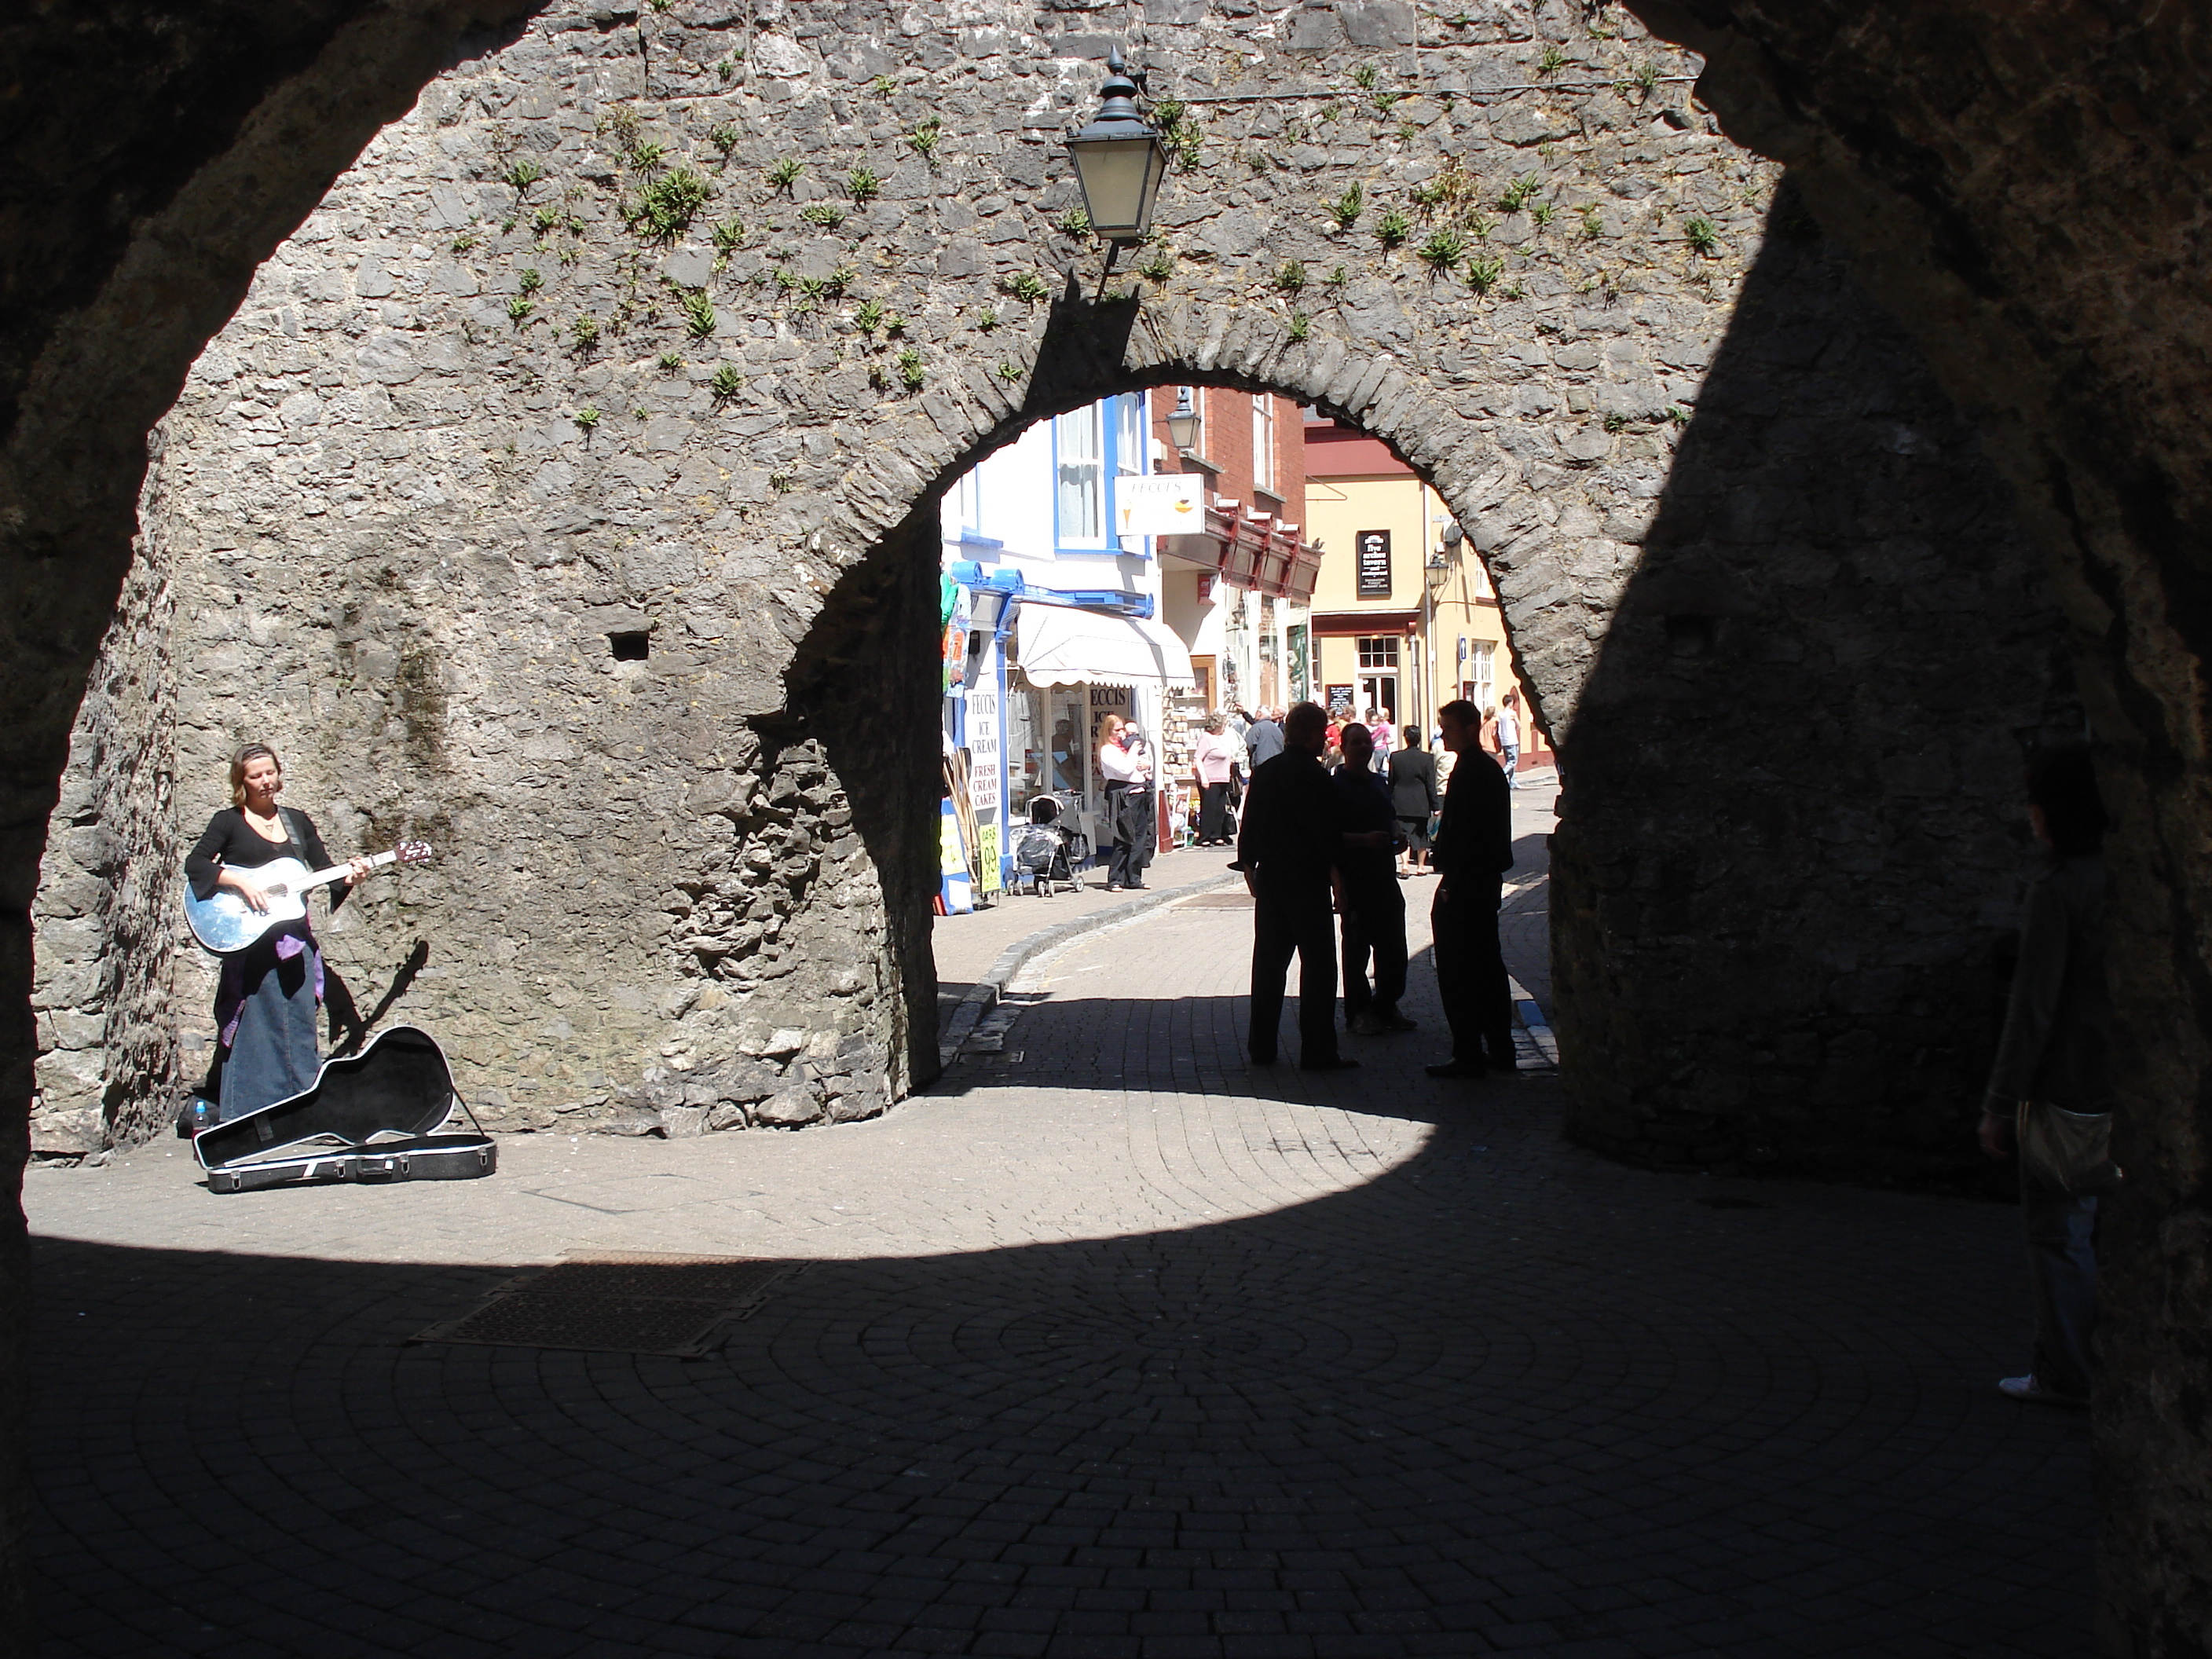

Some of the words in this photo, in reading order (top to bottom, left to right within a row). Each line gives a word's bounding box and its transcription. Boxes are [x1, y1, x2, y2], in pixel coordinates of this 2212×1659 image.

[972, 694, 996, 715] FECCIS
[1091, 688, 1126, 706] ECCIS
[979, 721, 990, 735] ICE
[972, 738, 997, 754] CREAM
[974, 764, 995, 778] FRESH
[973, 778, 997, 793] CREAM
[975, 793, 996, 807] CAKES
